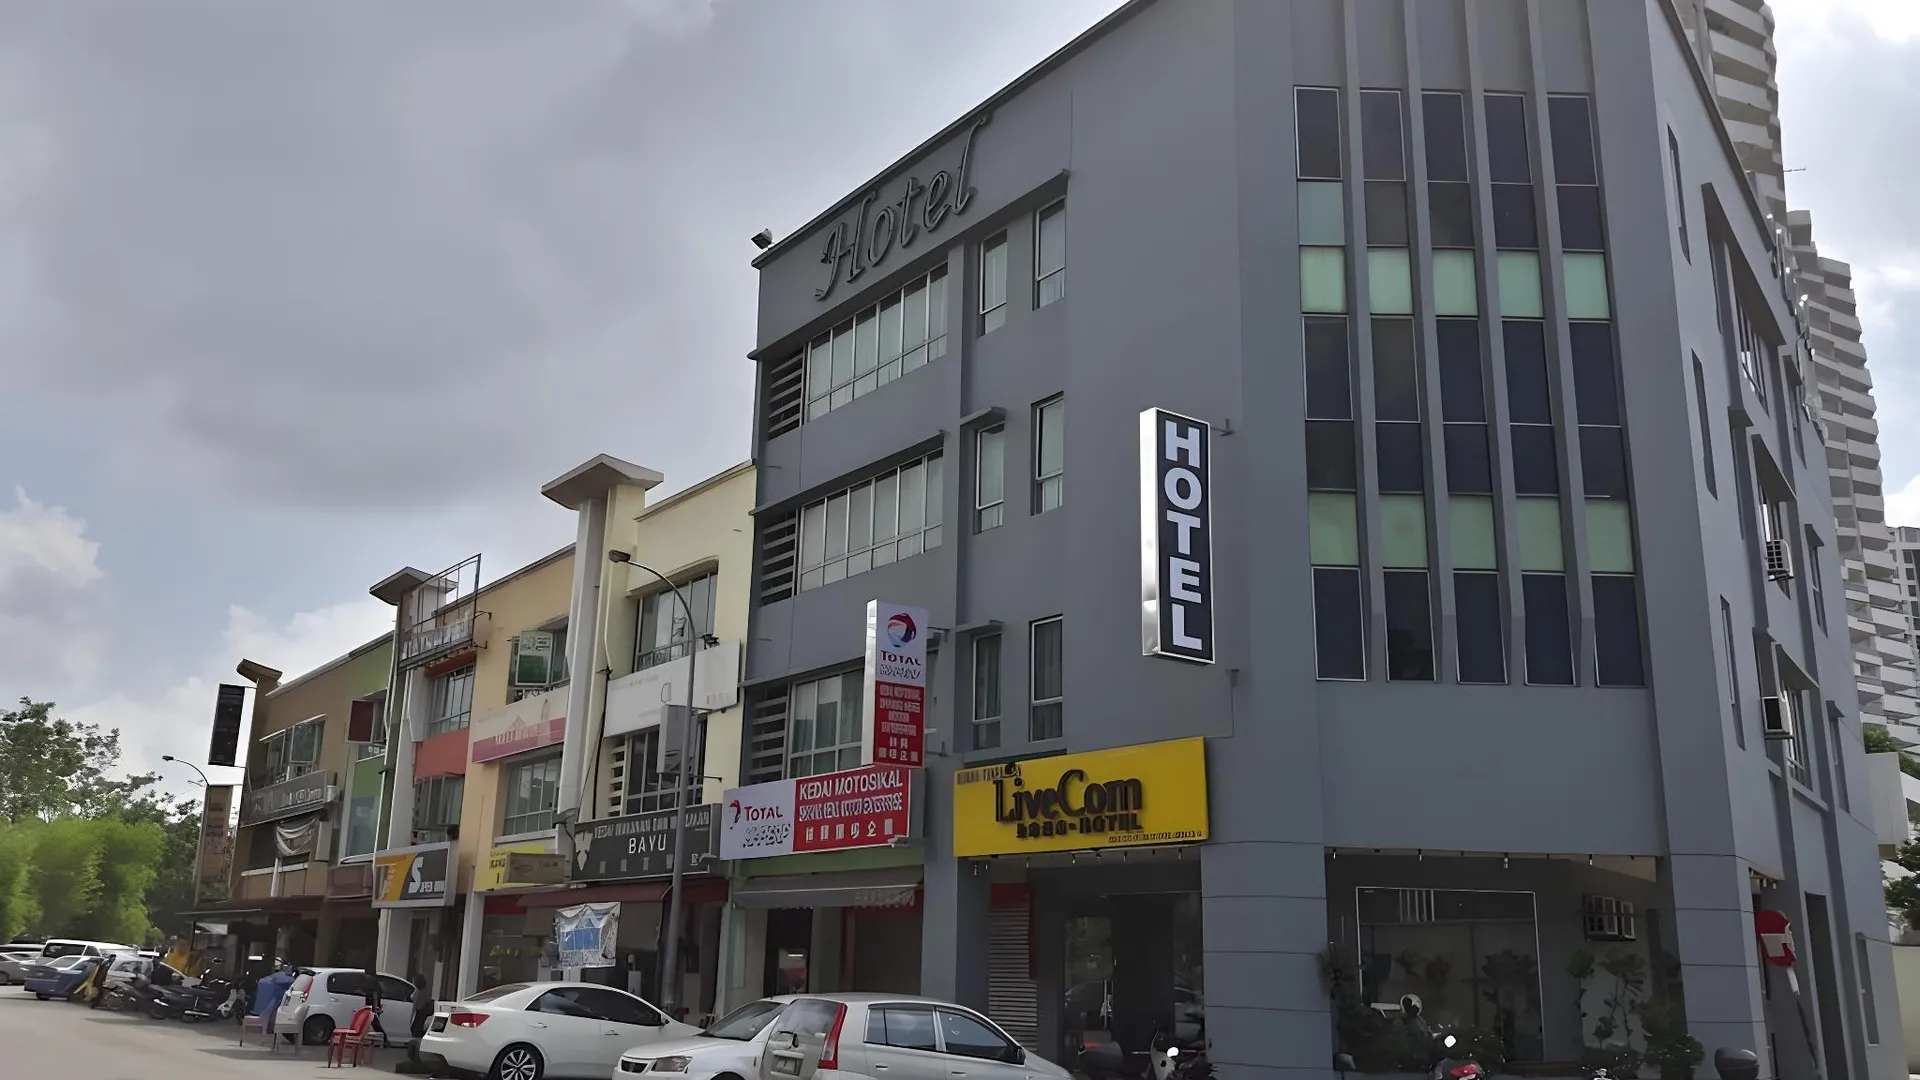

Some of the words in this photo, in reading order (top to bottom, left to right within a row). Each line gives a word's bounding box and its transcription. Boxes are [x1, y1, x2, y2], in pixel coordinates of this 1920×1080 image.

[814, 115, 986, 301] Hotel
[1164, 420, 1203, 651] HOTEL
[881, 650, 922, 667] TOTAL
[744, 805, 784, 822] TOTAL
[993, 768, 1143, 823] LiveCom
[628, 833, 667, 854] BAYU
